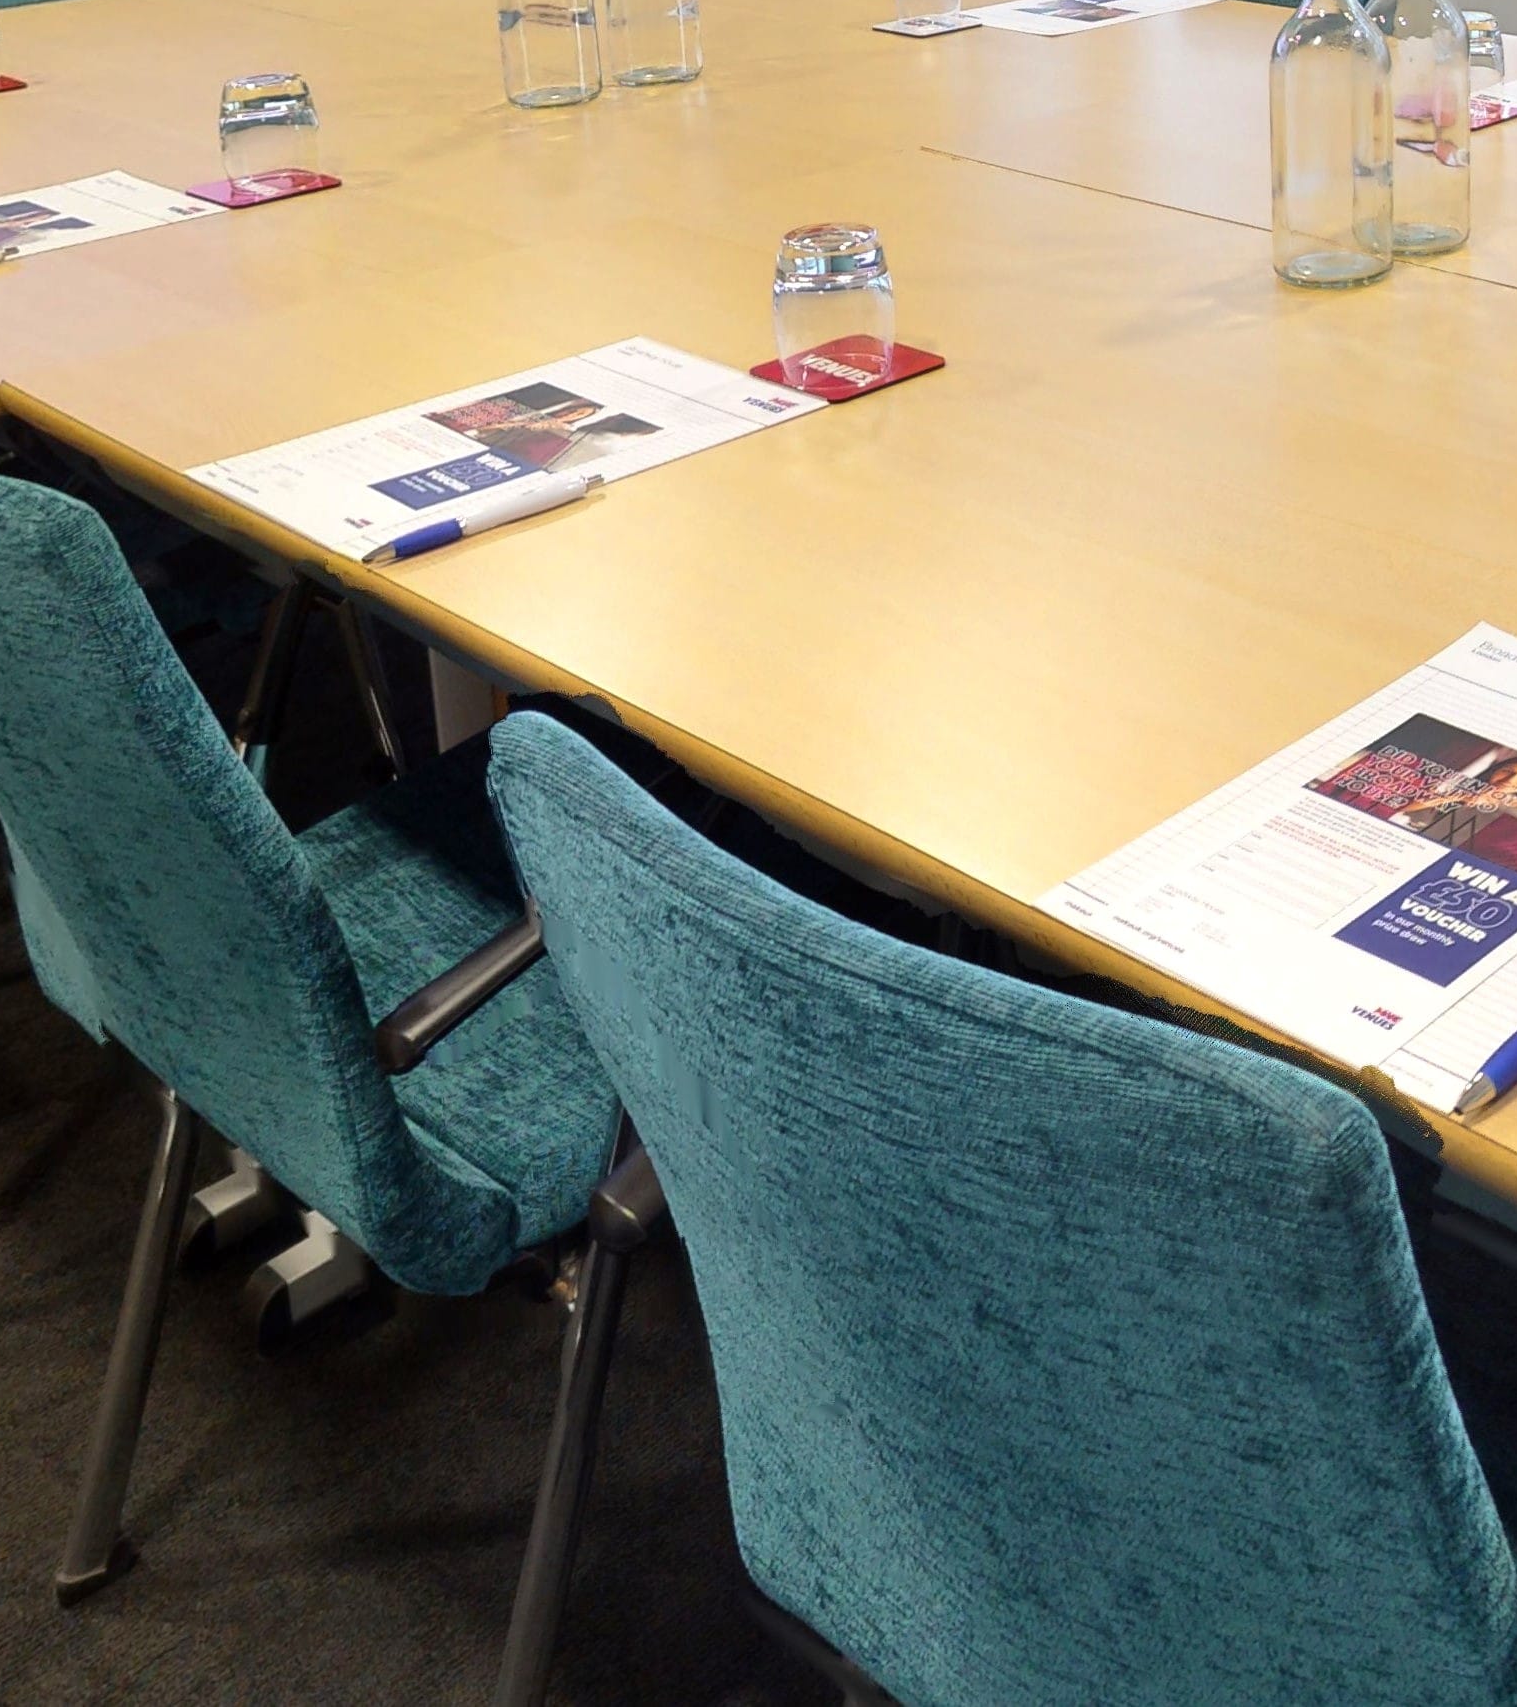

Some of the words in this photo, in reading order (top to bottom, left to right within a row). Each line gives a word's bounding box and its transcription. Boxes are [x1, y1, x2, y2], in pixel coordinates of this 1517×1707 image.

[799, 354, 881, 388] VENUES
[1447, 861, 1510, 895] WIN
[1400, 898, 1488, 944] VOUCHER
[1409, 879, 1514, 930] £50
[1372, 918, 1398, 937] prize
[1398, 927, 1428, 946] draw
[1393, 914, 1414, 929] our
[1412, 922, 1456, 947] monthly
[1351, 1005, 1396, 1031] VENUES
